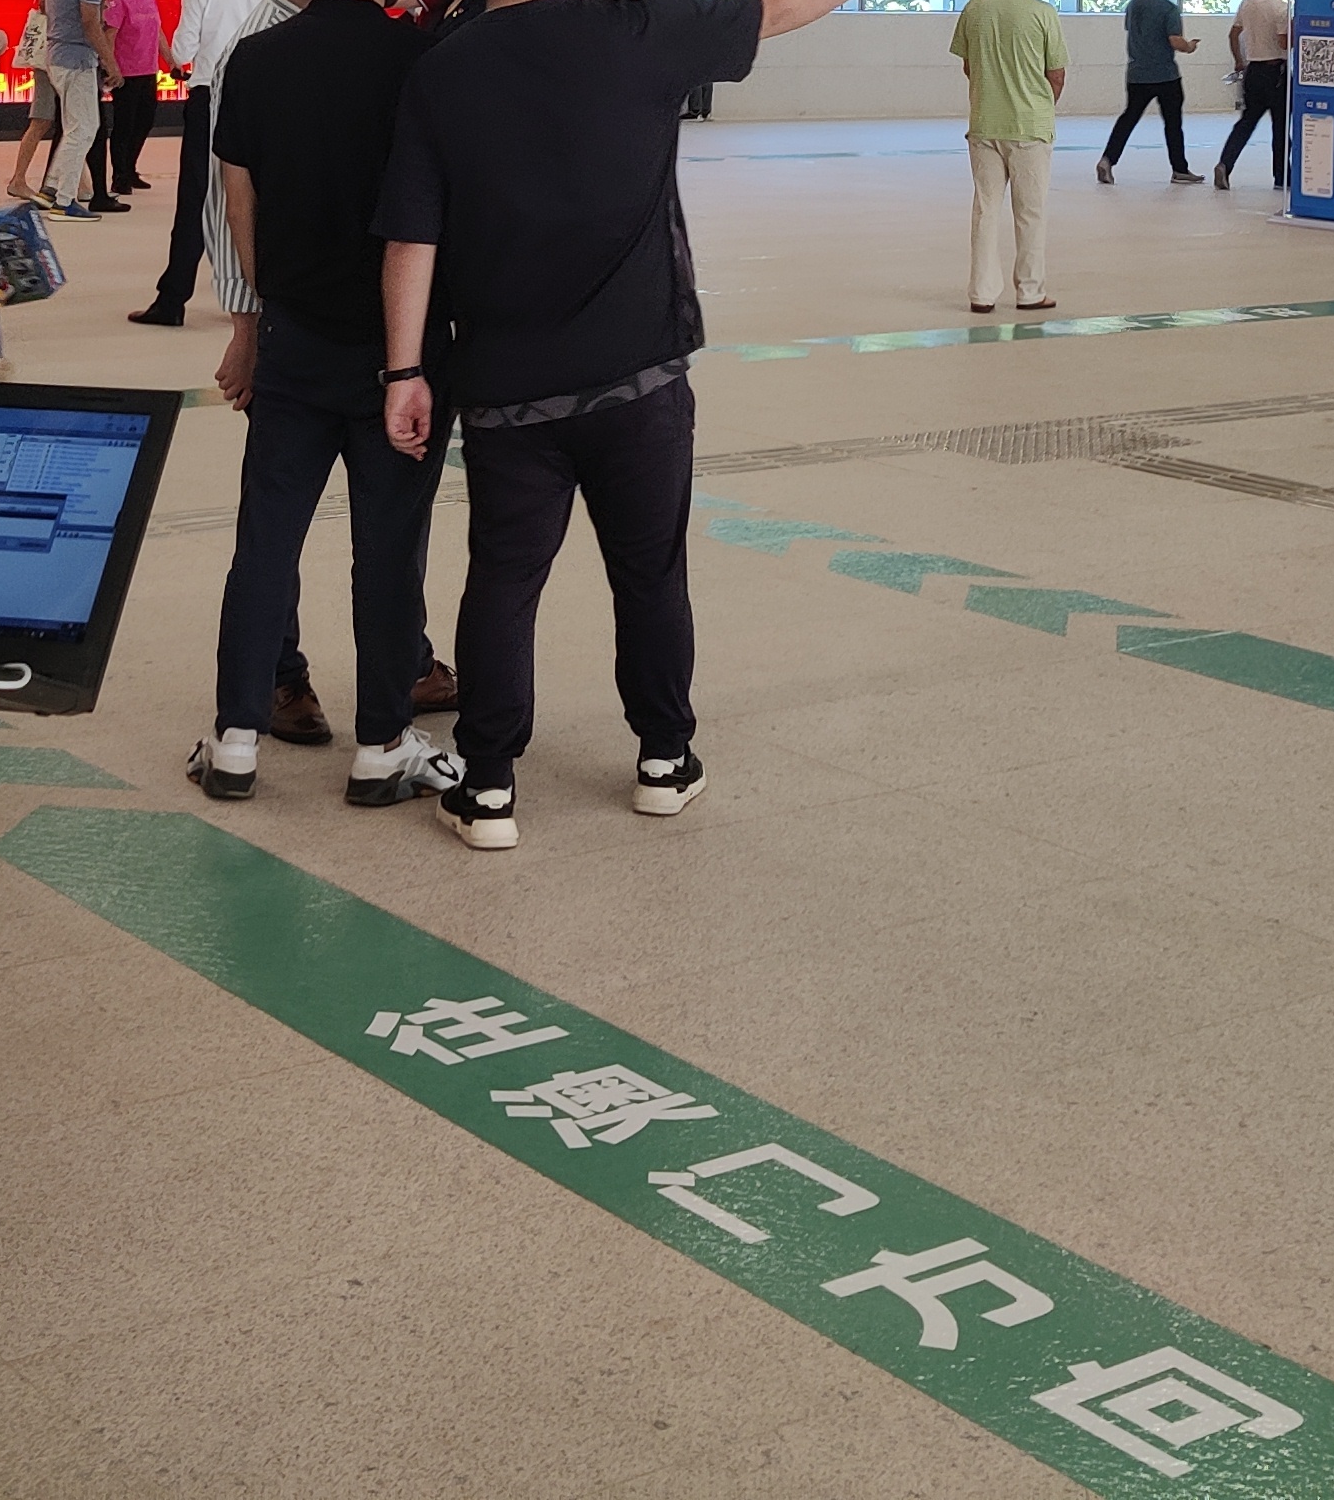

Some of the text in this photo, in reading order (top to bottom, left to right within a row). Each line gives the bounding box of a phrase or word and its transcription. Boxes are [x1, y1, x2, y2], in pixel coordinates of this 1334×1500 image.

[365, 995, 1304, 1478] 往澳门方向
